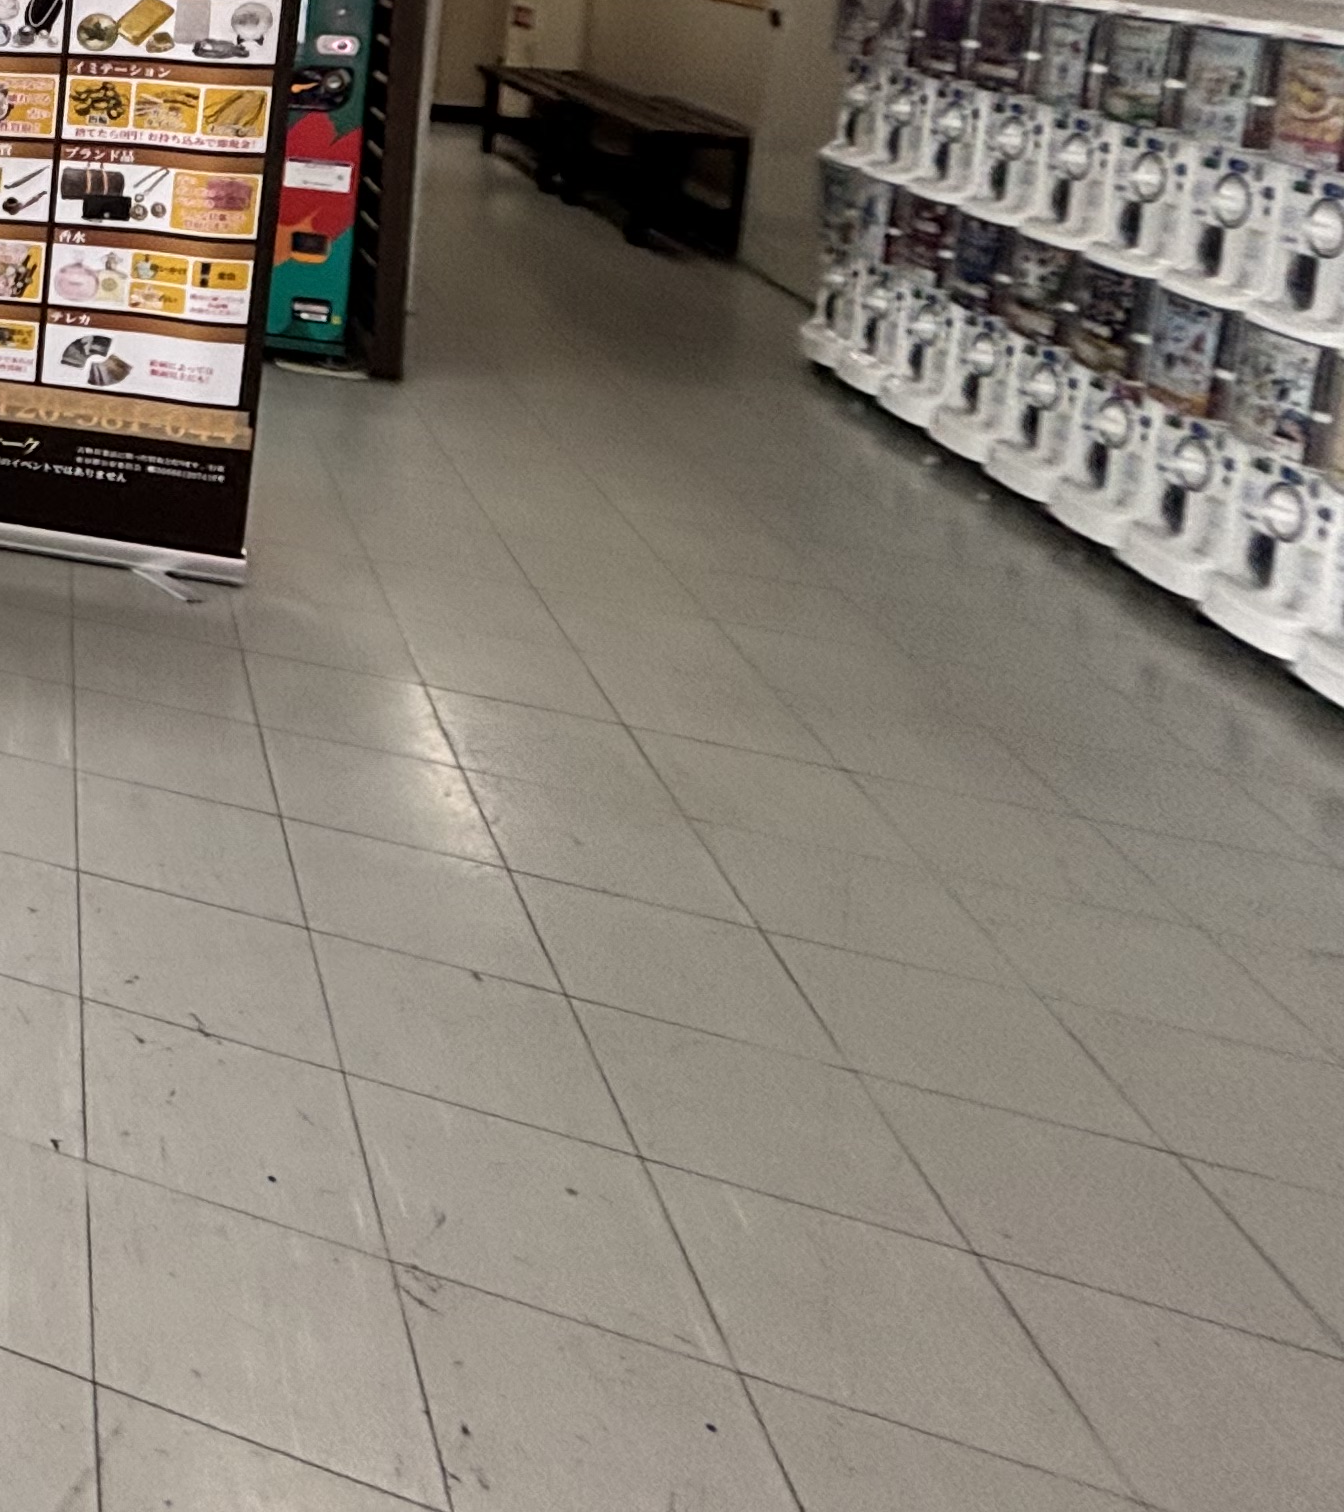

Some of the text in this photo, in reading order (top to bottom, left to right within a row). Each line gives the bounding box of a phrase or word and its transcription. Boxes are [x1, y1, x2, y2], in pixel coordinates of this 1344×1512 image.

[73, 62, 172, 78] イミテーション
[64, 147, 135, 163] ブランド品
[51, 312, 91, 326] テレカ
